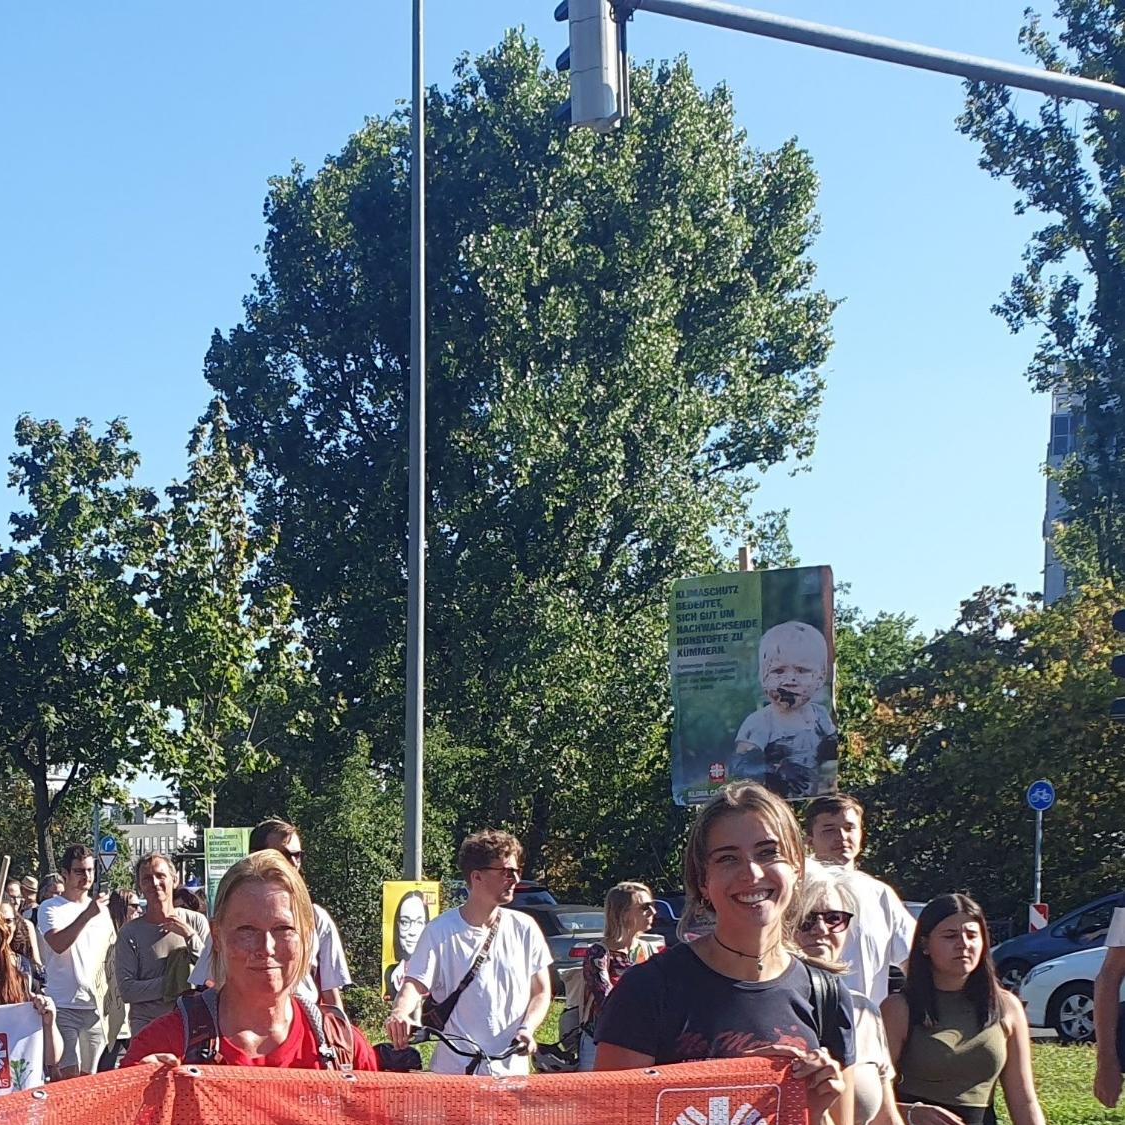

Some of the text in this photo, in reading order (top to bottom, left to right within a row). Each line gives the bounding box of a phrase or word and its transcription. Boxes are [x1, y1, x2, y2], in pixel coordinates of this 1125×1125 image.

[676, 585, 739, 598] KLIMASCHUTZ
[676, 609, 735, 623] SICH GUT UM
[676, 619, 758, 634] NACHWACHSENDE
[731, 632, 743, 641] ZU
